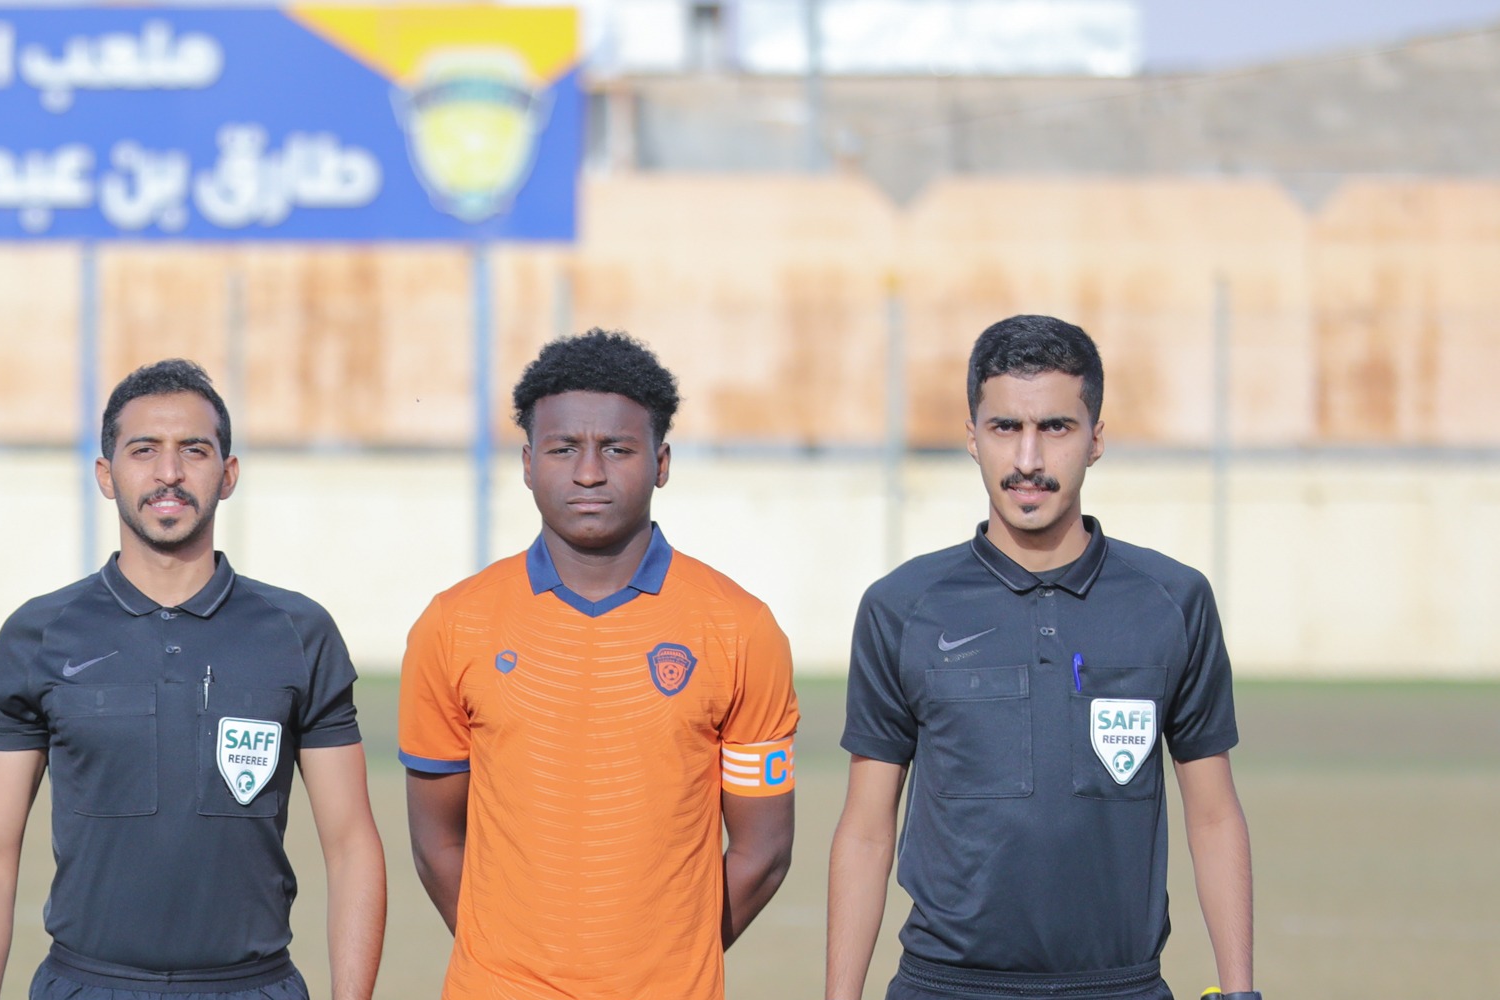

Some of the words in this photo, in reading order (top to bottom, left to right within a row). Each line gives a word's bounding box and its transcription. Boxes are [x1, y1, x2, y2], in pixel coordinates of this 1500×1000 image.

[20, 18, 224, 114] ملعب
[100, 140, 189, 231] بن
[195, 125, 382, 228] طارق
[1097, 709, 1152, 730] SAFF
[224, 729, 276, 751] SAFF
[1102, 735, 1147, 745] REFEREE
[228, 754, 268, 767] REFEREE
[764, 750, 787, 786] C
